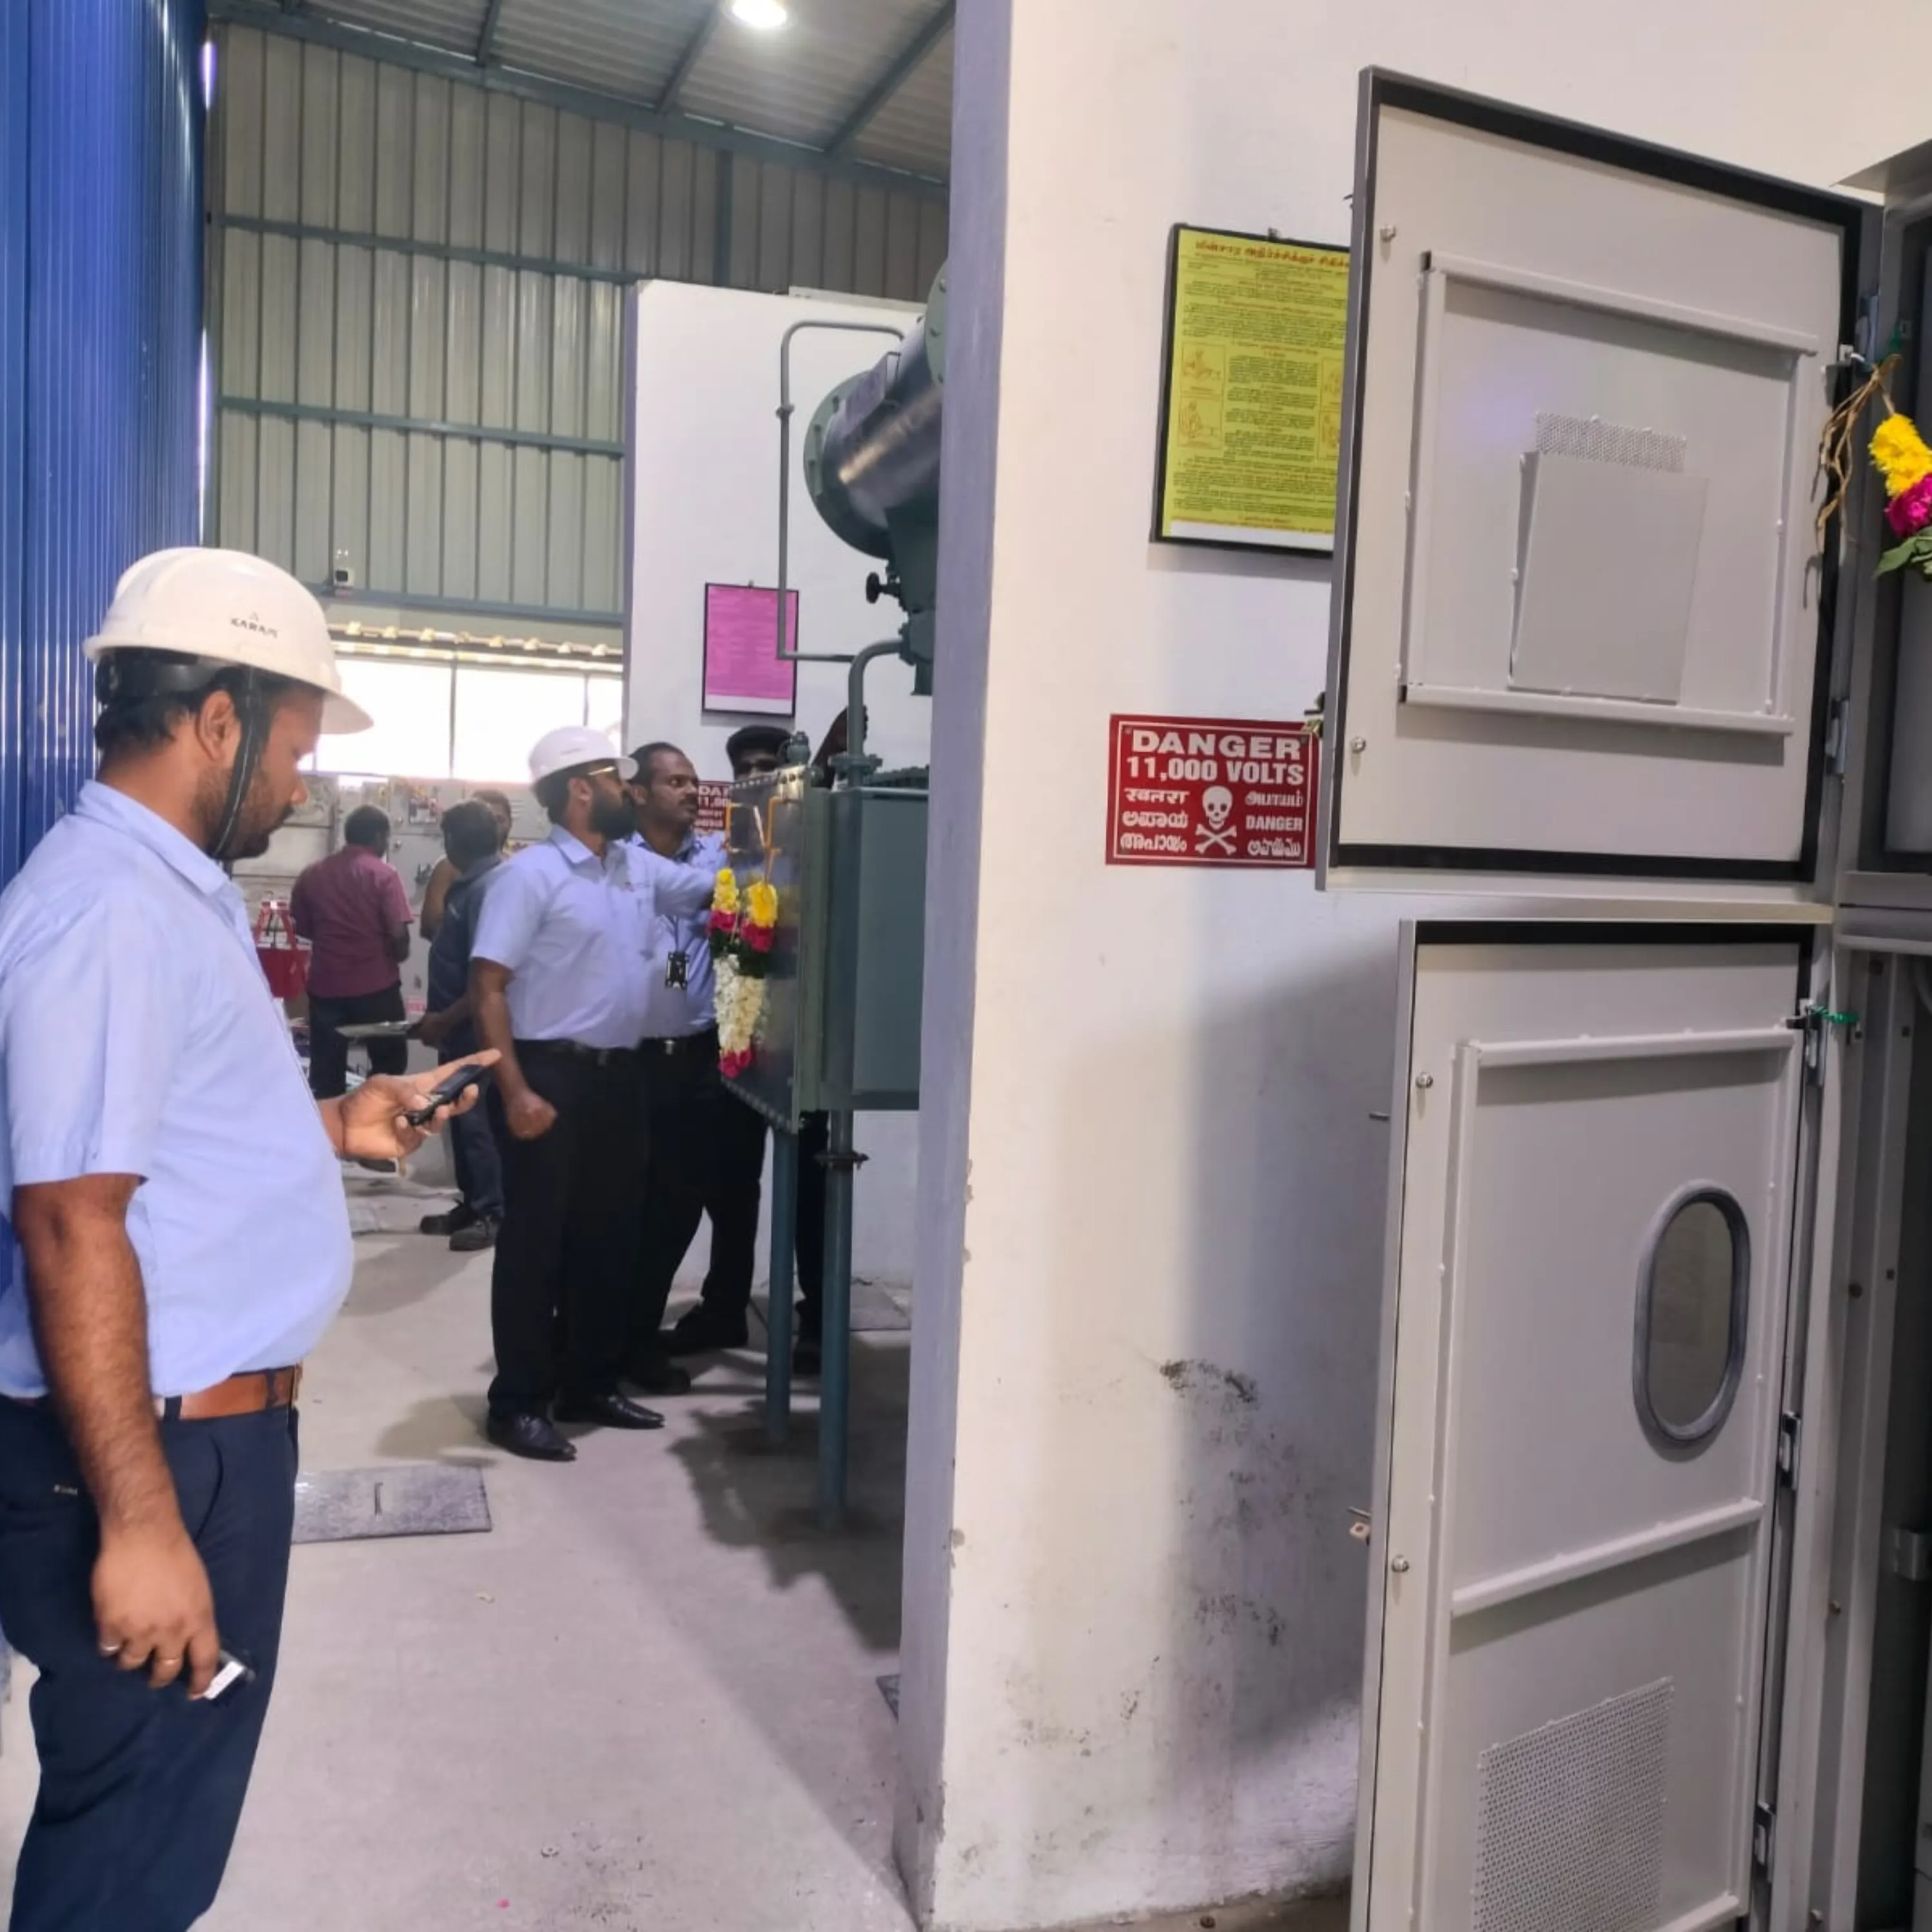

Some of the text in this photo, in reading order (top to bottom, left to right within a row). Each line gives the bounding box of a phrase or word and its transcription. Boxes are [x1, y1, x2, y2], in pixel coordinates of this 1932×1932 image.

[1132, 730, 1300, 761] DANGER
[1127, 757, 1303, 785] 11,000 VOLTS
[1245, 815, 1303, 831] DANGER
